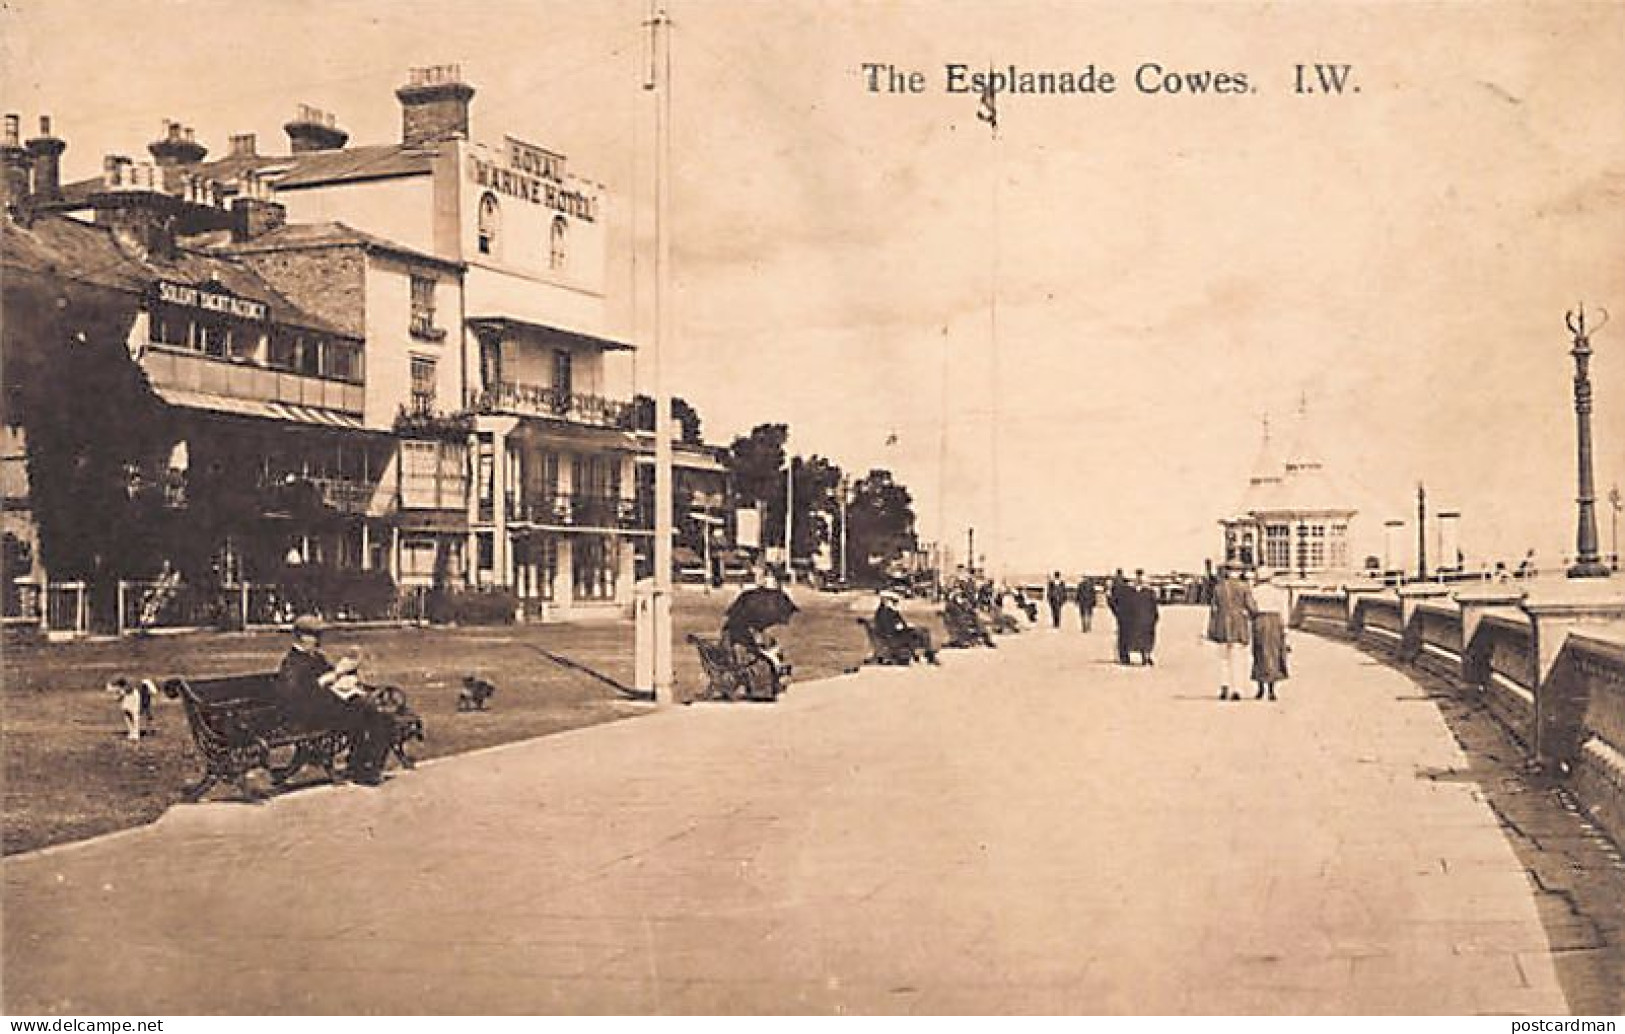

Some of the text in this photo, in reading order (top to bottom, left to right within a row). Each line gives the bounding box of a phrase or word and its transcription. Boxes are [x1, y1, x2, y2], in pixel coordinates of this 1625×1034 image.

[474, 158, 596, 223] MARINE HOTEL
[510, 145, 563, 184] ROYAL
